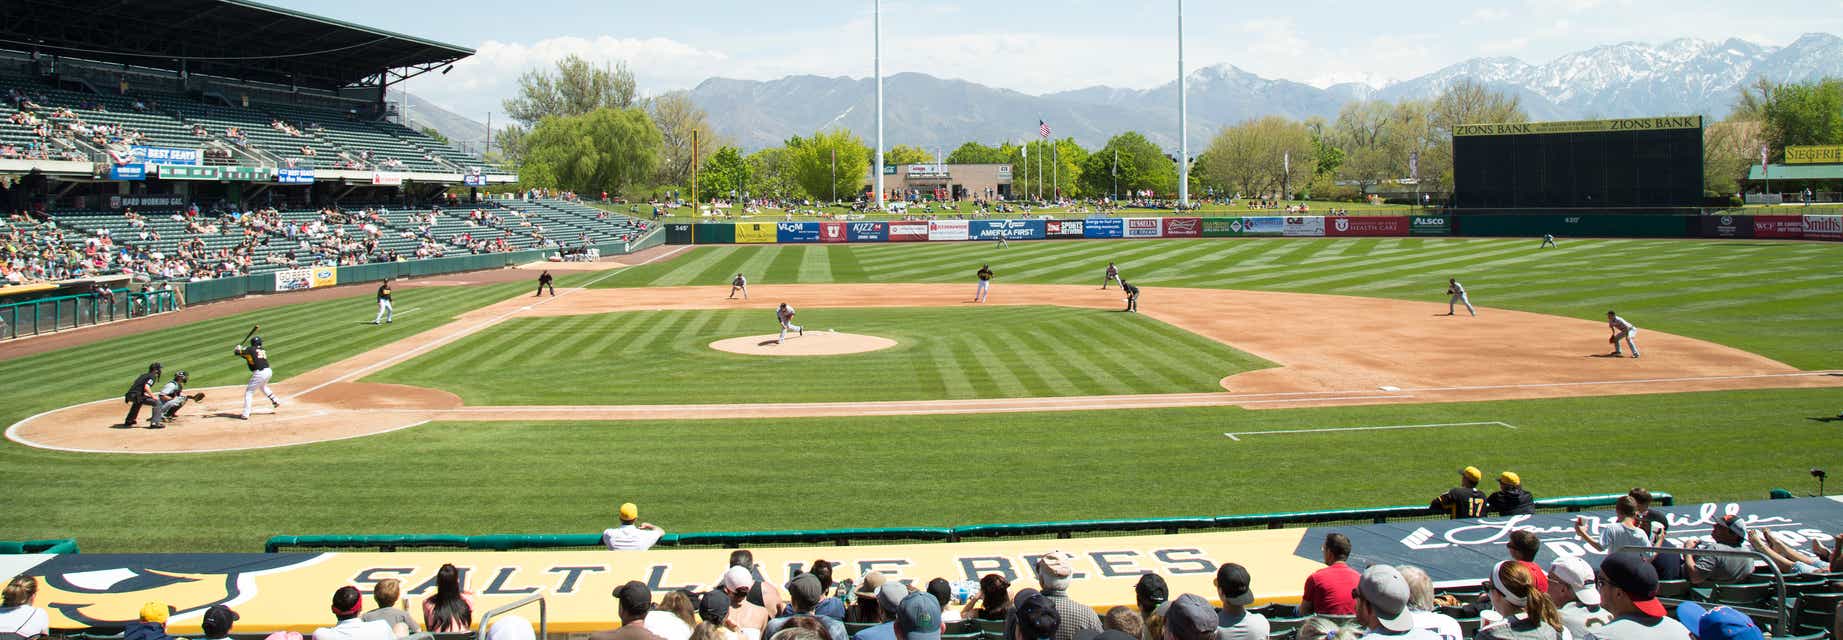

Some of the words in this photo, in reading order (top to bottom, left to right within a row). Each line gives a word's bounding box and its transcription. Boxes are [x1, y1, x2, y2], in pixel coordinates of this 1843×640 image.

[1456, 124, 1494, 135] ZIONS
[1497, 123, 1531, 134] BANK
[1610, 119, 1652, 130] ZIONS
[1655, 117, 1695, 128] BANK
[147, 148, 169, 159] BEST
[1413, 217, 1445, 225] ALSCO
[1803, 215, 1841, 232] Smith's
[980, 229, 1012, 237] AMERICA
[1013, 228, 1035, 236] FIRST
[1468, 497, 1485, 518] 17
